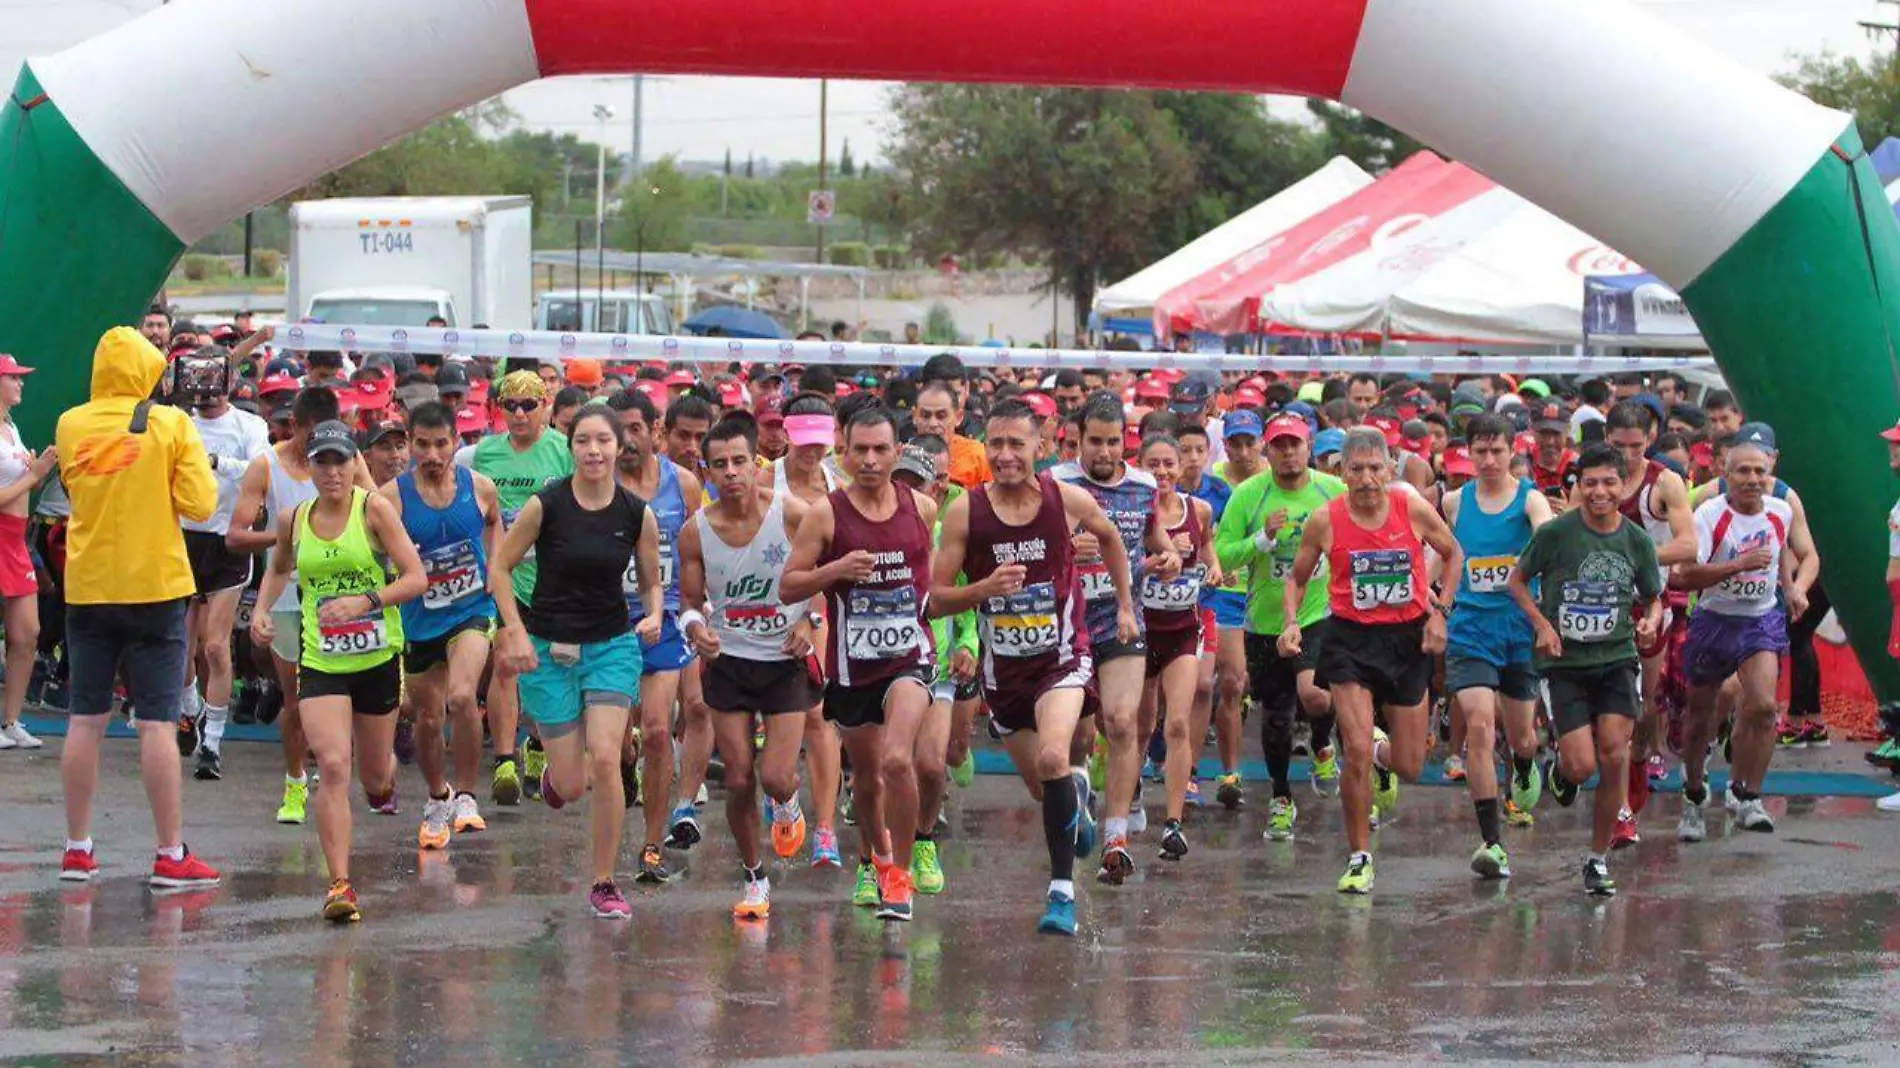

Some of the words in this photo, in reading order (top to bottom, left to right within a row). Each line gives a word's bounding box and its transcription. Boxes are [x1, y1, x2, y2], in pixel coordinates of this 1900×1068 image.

[360, 232, 413, 253] TI-044
[993, 542, 1016, 554] URIEL
[1018, 537, 1046, 551] ACUÑA
[875, 551, 904, 565] UTURO
[1016, 550, 1045, 562] FUTURO
[885, 566, 913, 581] ACUÑA
[1471, 565, 1510, 584] 549
[1144, 582, 1197, 601] 5537
[1356, 584, 1409, 601] 5175
[1562, 613, 1614, 632] 5016
[323, 629, 381, 653] 5301
[850, 625, 915, 648] 7009
[994, 624, 1056, 645] 5302
